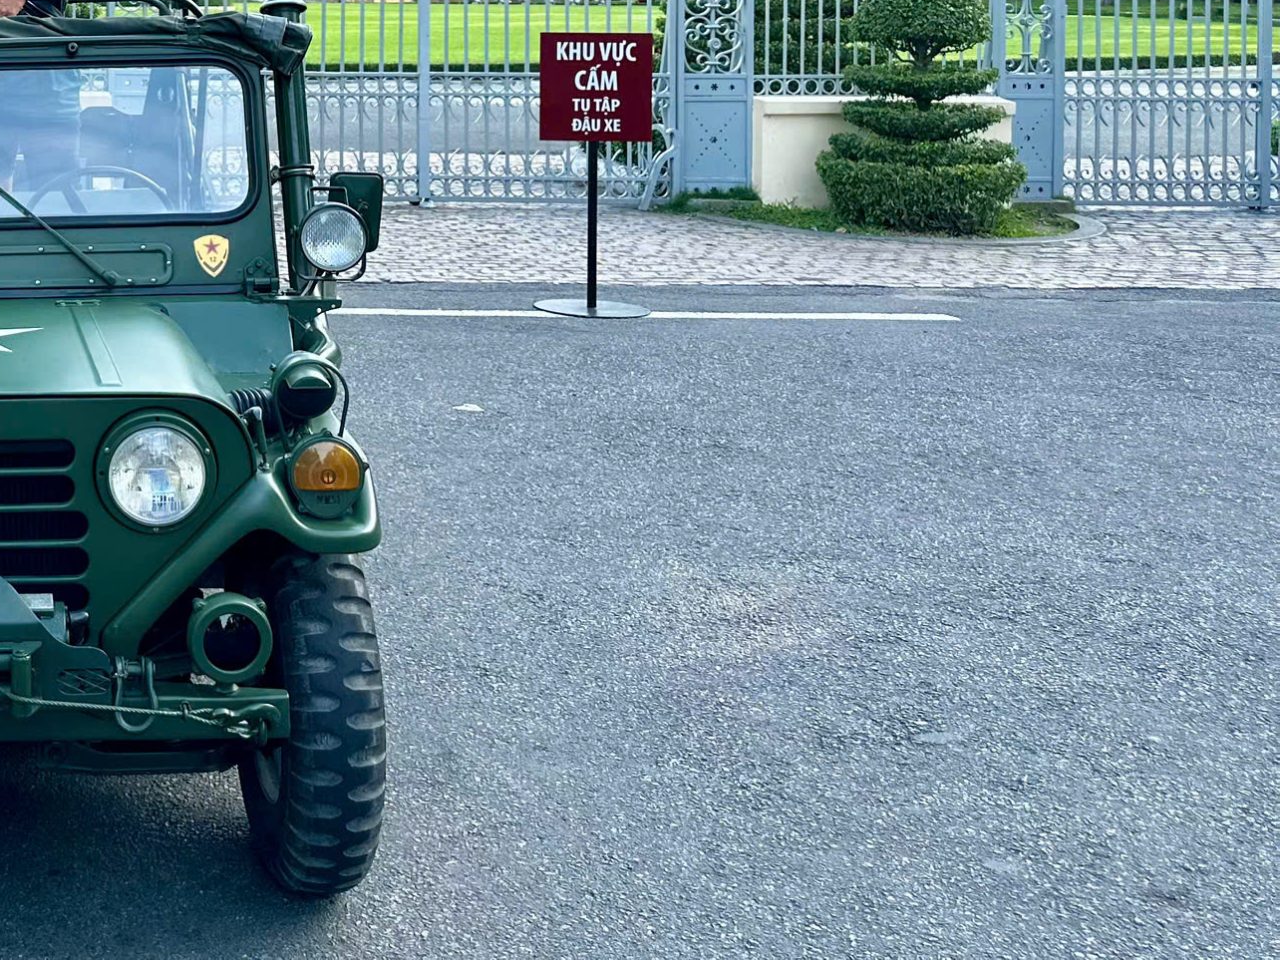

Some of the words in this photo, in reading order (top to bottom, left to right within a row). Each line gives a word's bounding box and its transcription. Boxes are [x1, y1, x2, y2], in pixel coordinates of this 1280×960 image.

[556, 41, 595, 61] KHU
[599, 40, 637, 66] VỰC
[574, 64, 618, 91] CẤM
[572, 98, 591, 115] TỤ
[593, 96, 621, 115] TẬP
[571, 116, 601, 135] ĐẬU
[604, 118, 621, 132] XE
